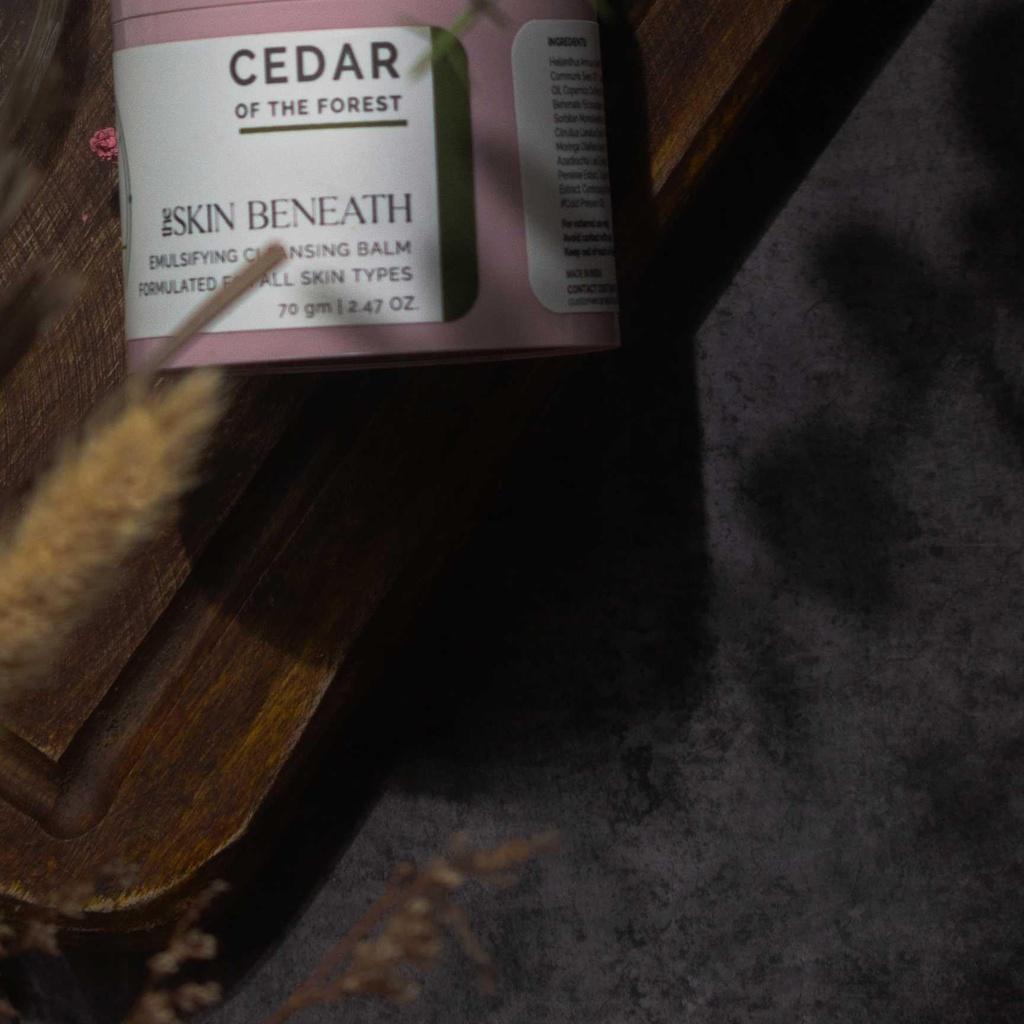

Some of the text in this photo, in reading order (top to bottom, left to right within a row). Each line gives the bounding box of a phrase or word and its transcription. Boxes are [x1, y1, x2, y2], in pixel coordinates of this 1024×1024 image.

[229, 41, 400, 86] CEDAR
[235, 95, 402, 119] OF THE FOREST
[173, 202, 235, 236] SKIN
[248, 193, 414, 230] BENEATH
[149, 248, 238, 270] EMULSIFYING
[357, 240, 412, 257] BALM
[139, 276, 216, 296] FORMULATED
[259, 271, 295, 287] ALL
[301, 269, 346, 286] SKIN
[352, 266, 414, 284] TYPES
[278, 303, 299, 318] 70
[304, 302, 333, 318] gm
[348, 299, 383, 314] 2.47
